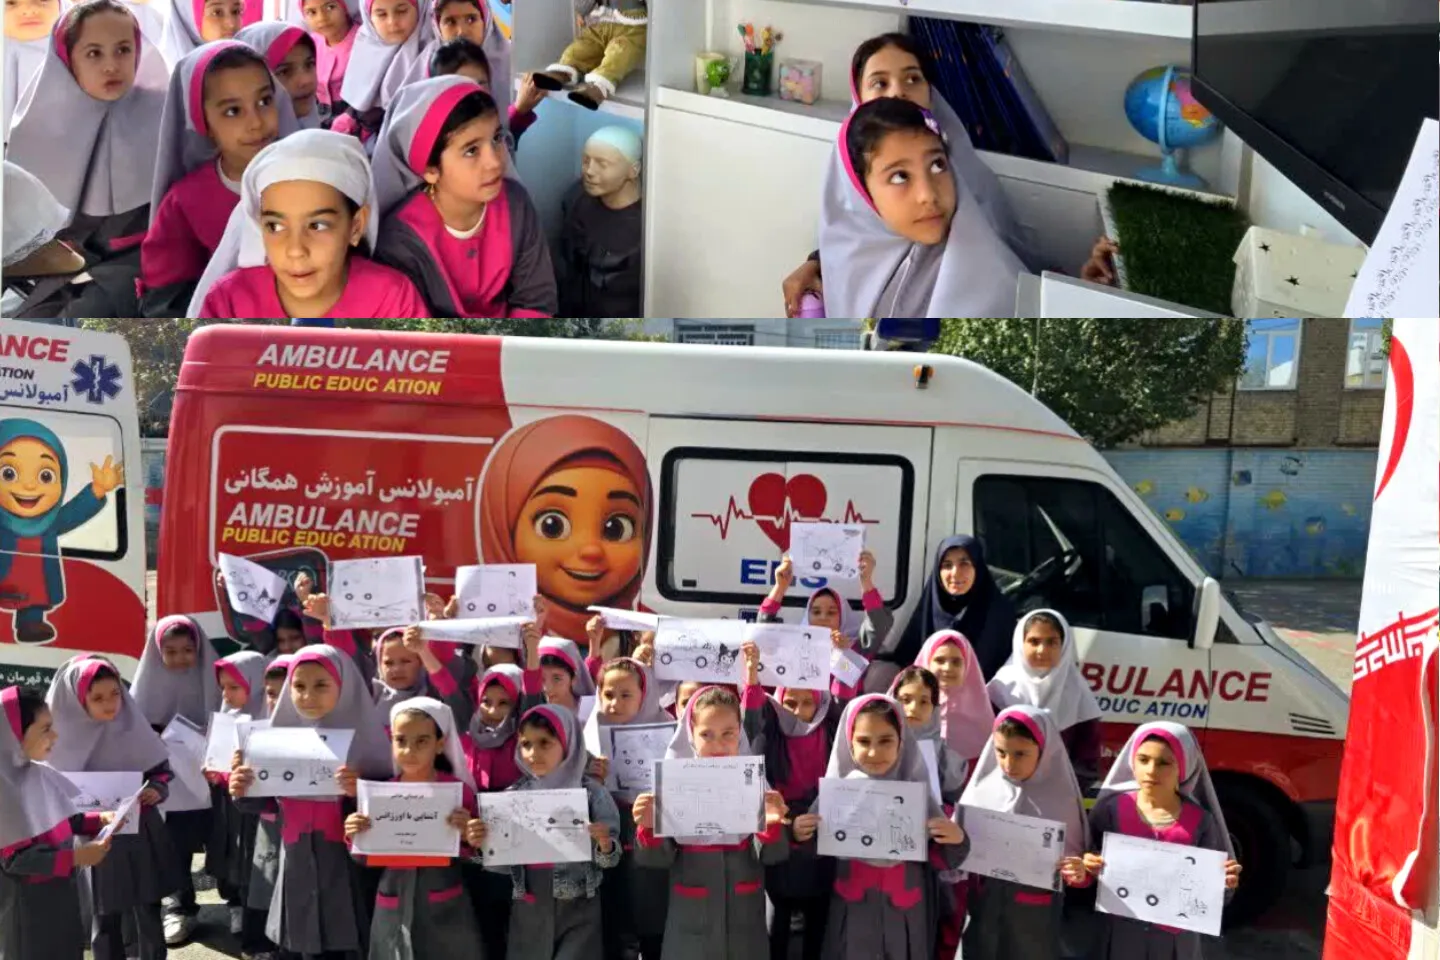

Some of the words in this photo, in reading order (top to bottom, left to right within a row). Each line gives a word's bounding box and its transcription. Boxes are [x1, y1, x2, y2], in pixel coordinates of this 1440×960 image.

[257, 343, 450, 373] AMBULANCE
[253, 373, 323, 390] PUBLIC
[326, 375, 379, 392] EDUC
[383, 378, 442, 395] ATION
[224, 467, 298, 494] همگانی
[304, 470, 376, 500] آموزش
[379, 477, 474, 505] آمبولانس
[226, 502, 420, 537] AMBULANCE
[221, 527, 290, 545] PUBLIC
[1080, 662, 1271, 702] BULANCE
[1095, 697, 1140, 714] DUC
[1144, 701, 1208, 719] ATION
